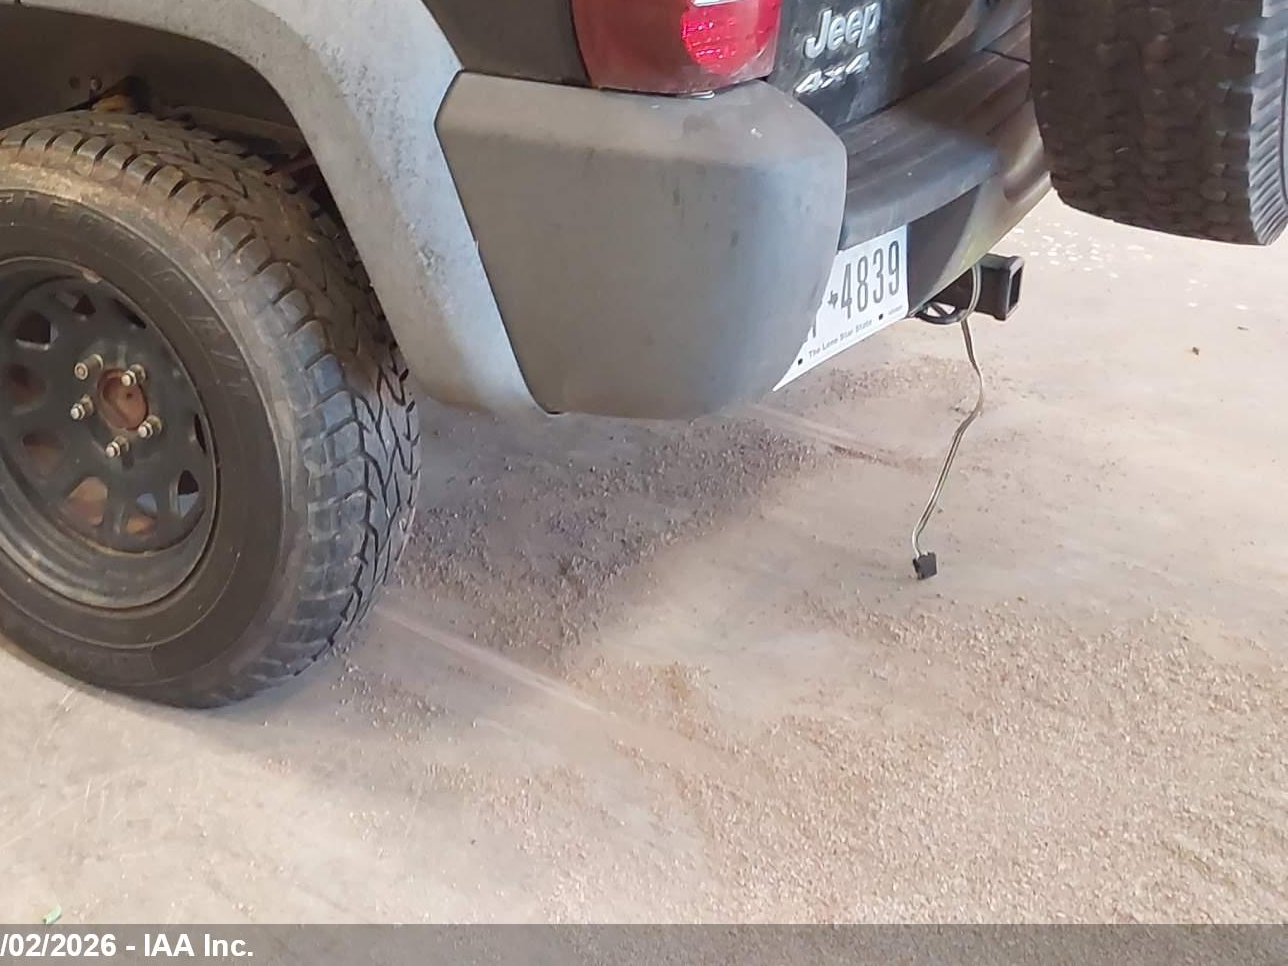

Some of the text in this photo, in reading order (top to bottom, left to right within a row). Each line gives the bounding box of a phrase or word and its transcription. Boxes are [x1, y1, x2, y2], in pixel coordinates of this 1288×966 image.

[803, 2, 881, 58] Jeep
[841, 240, 900, 320] 4839
[822, 337, 838, 350] Lone
